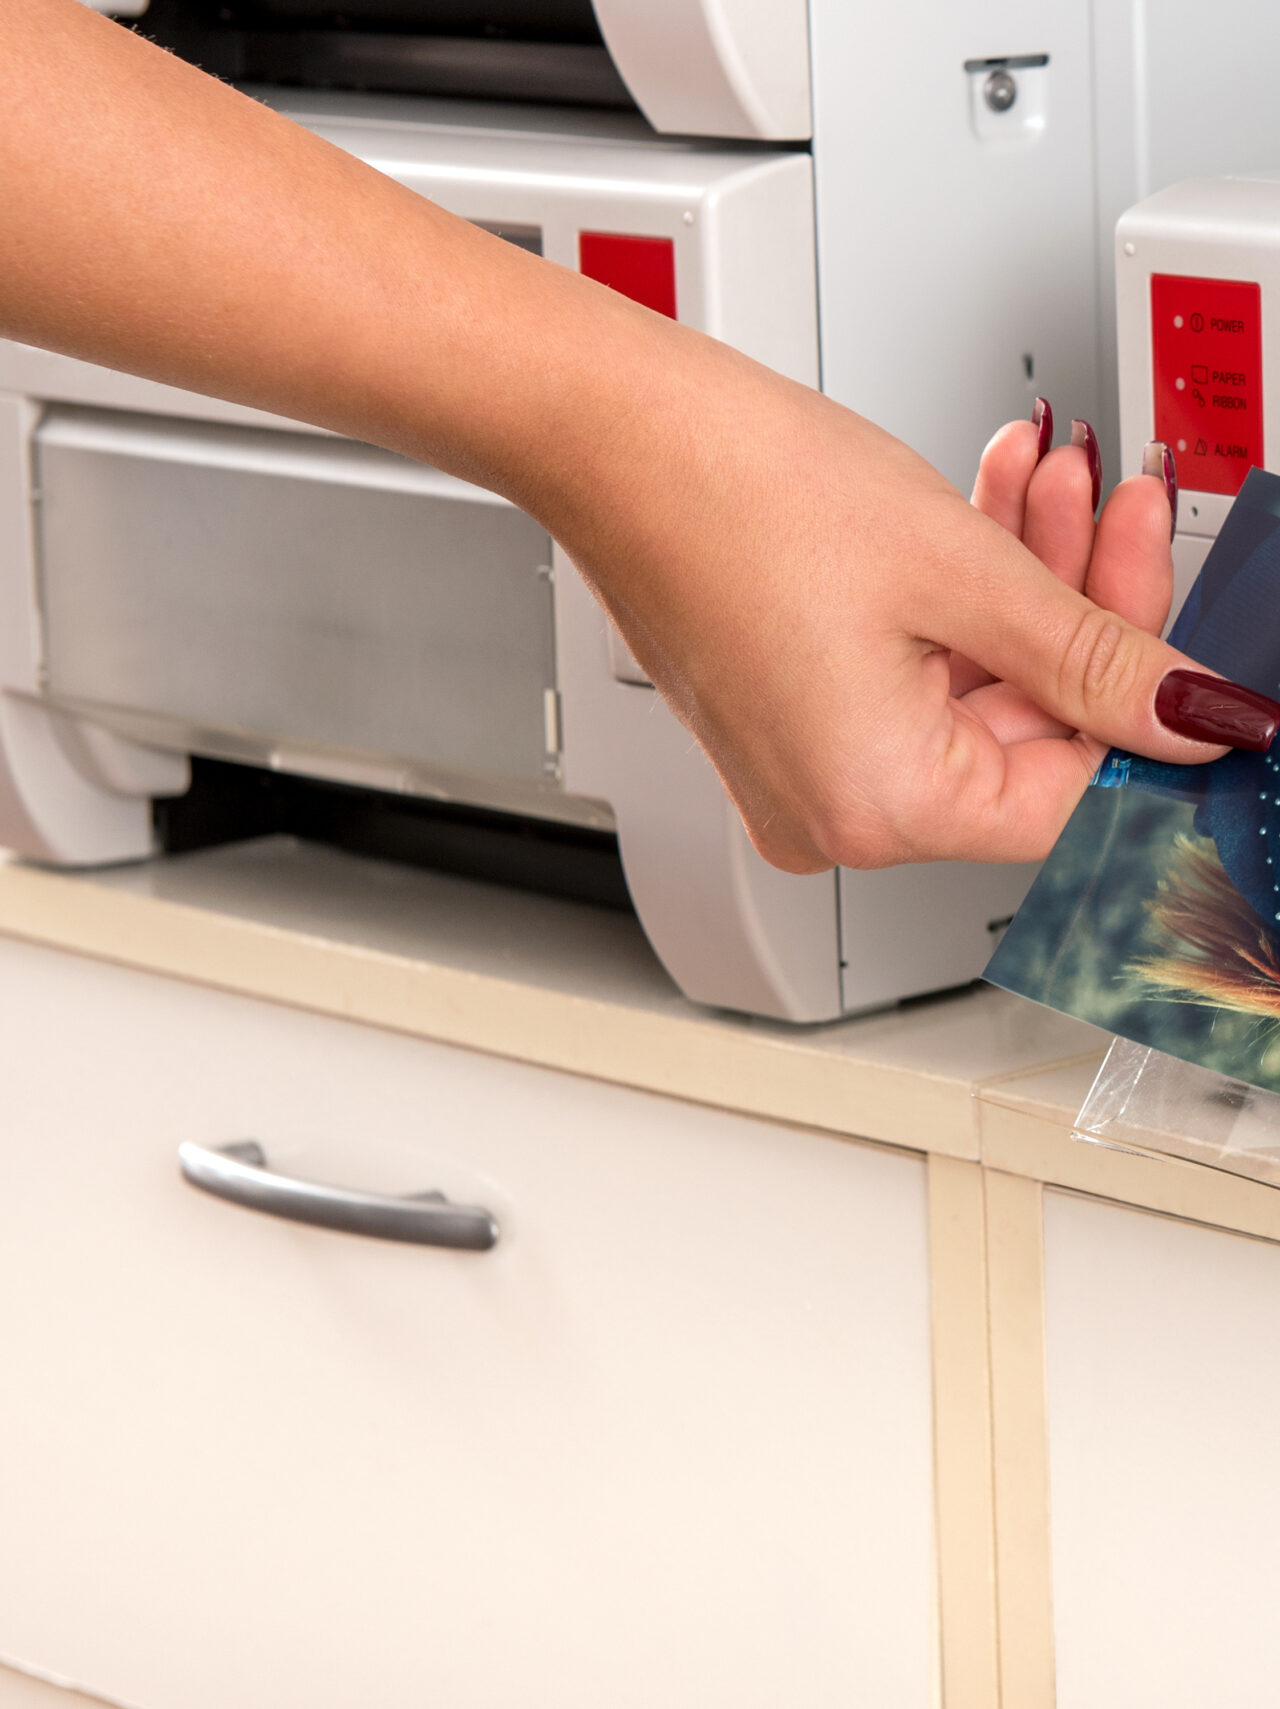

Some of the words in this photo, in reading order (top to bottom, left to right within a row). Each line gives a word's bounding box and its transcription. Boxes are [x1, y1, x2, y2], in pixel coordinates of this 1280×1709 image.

[1210, 318, 1245, 333] POWER
[1212, 370, 1246, 386] PAPER
[1212, 394, 1247, 410] RIBBON
[1214, 444, 1248, 459] ALARM
